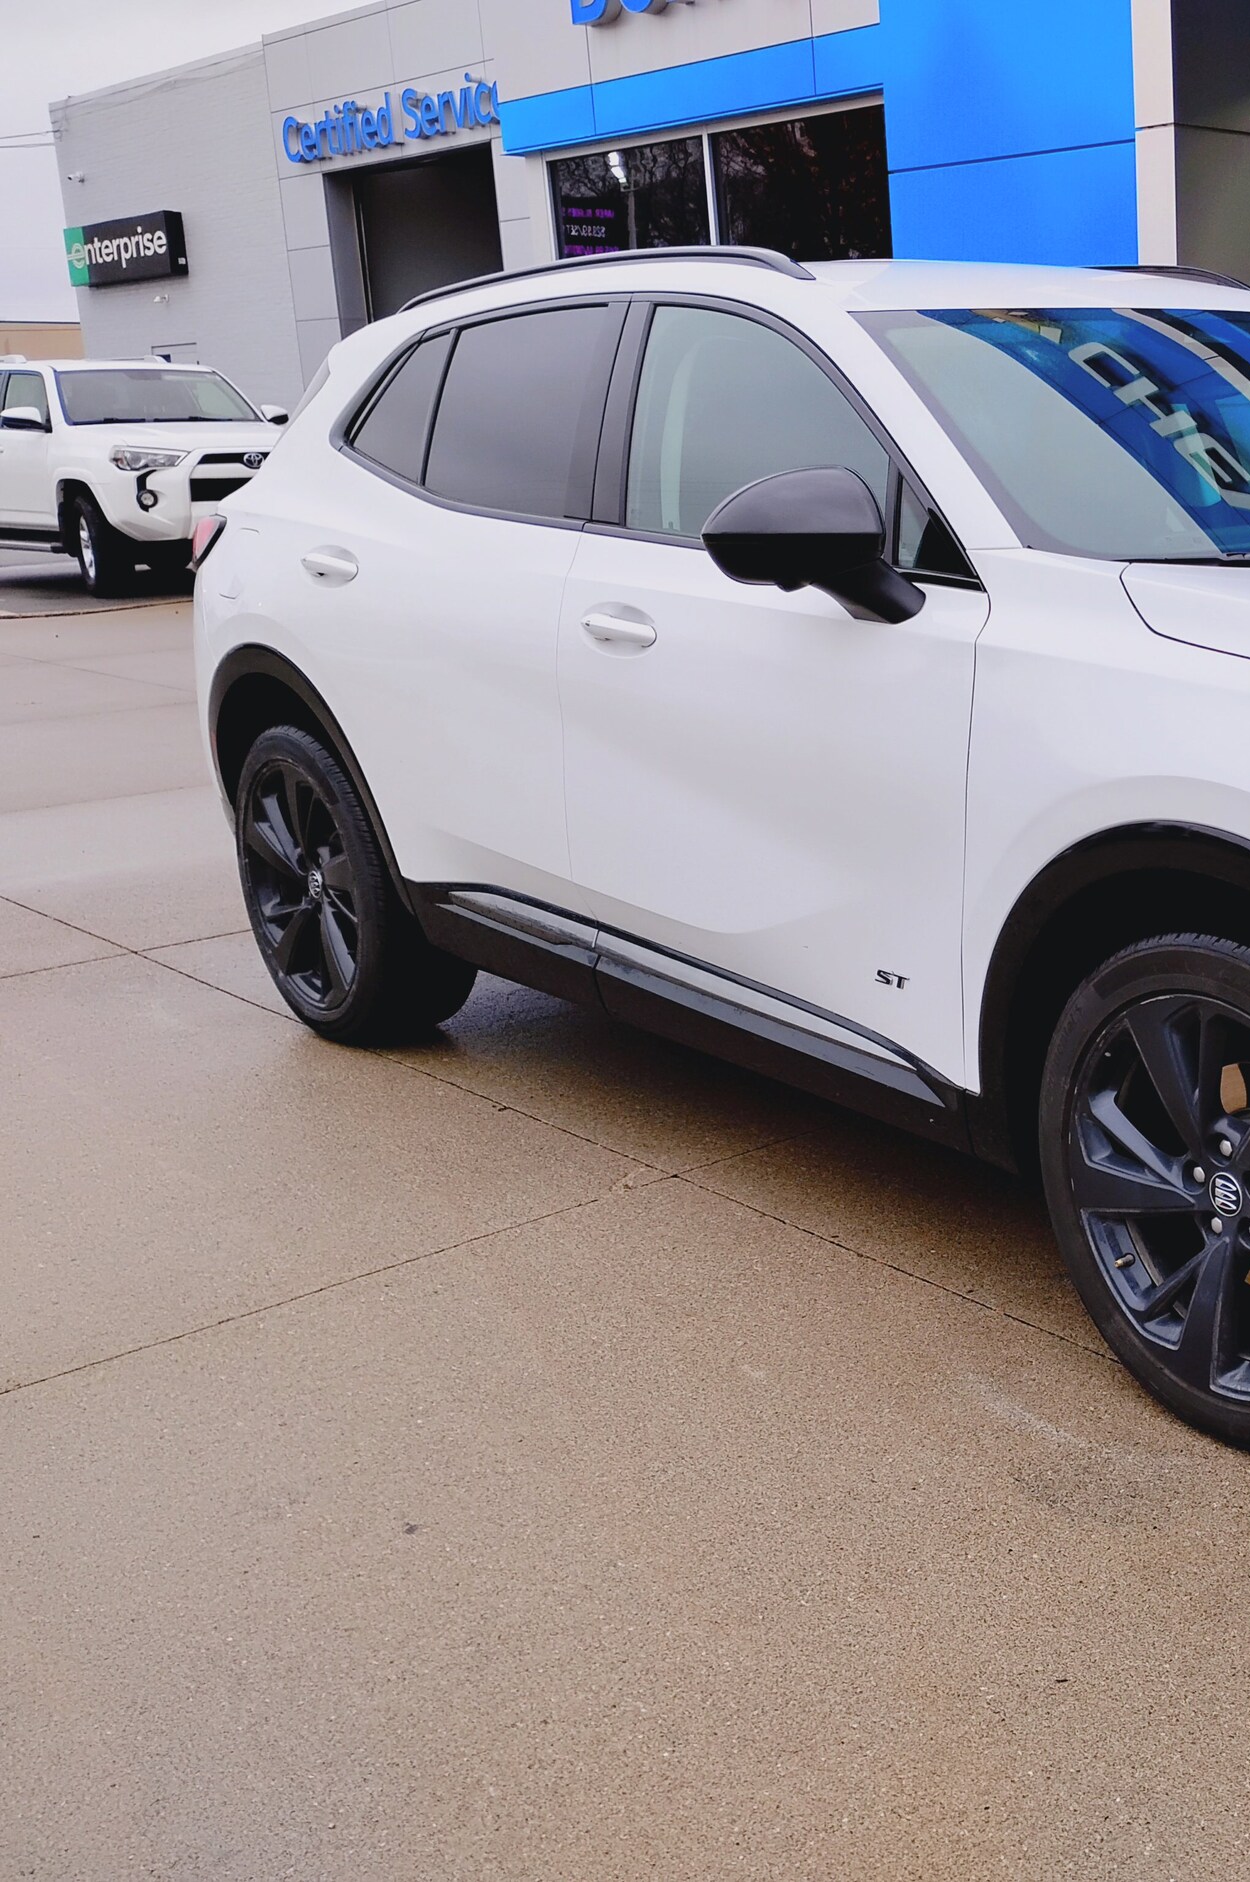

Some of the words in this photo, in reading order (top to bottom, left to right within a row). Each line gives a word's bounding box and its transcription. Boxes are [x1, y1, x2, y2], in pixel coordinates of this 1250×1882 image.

[282, 92, 395, 164] Certified
[66, 226, 167, 269] enterprise
[874, 969, 911, 990] ST
